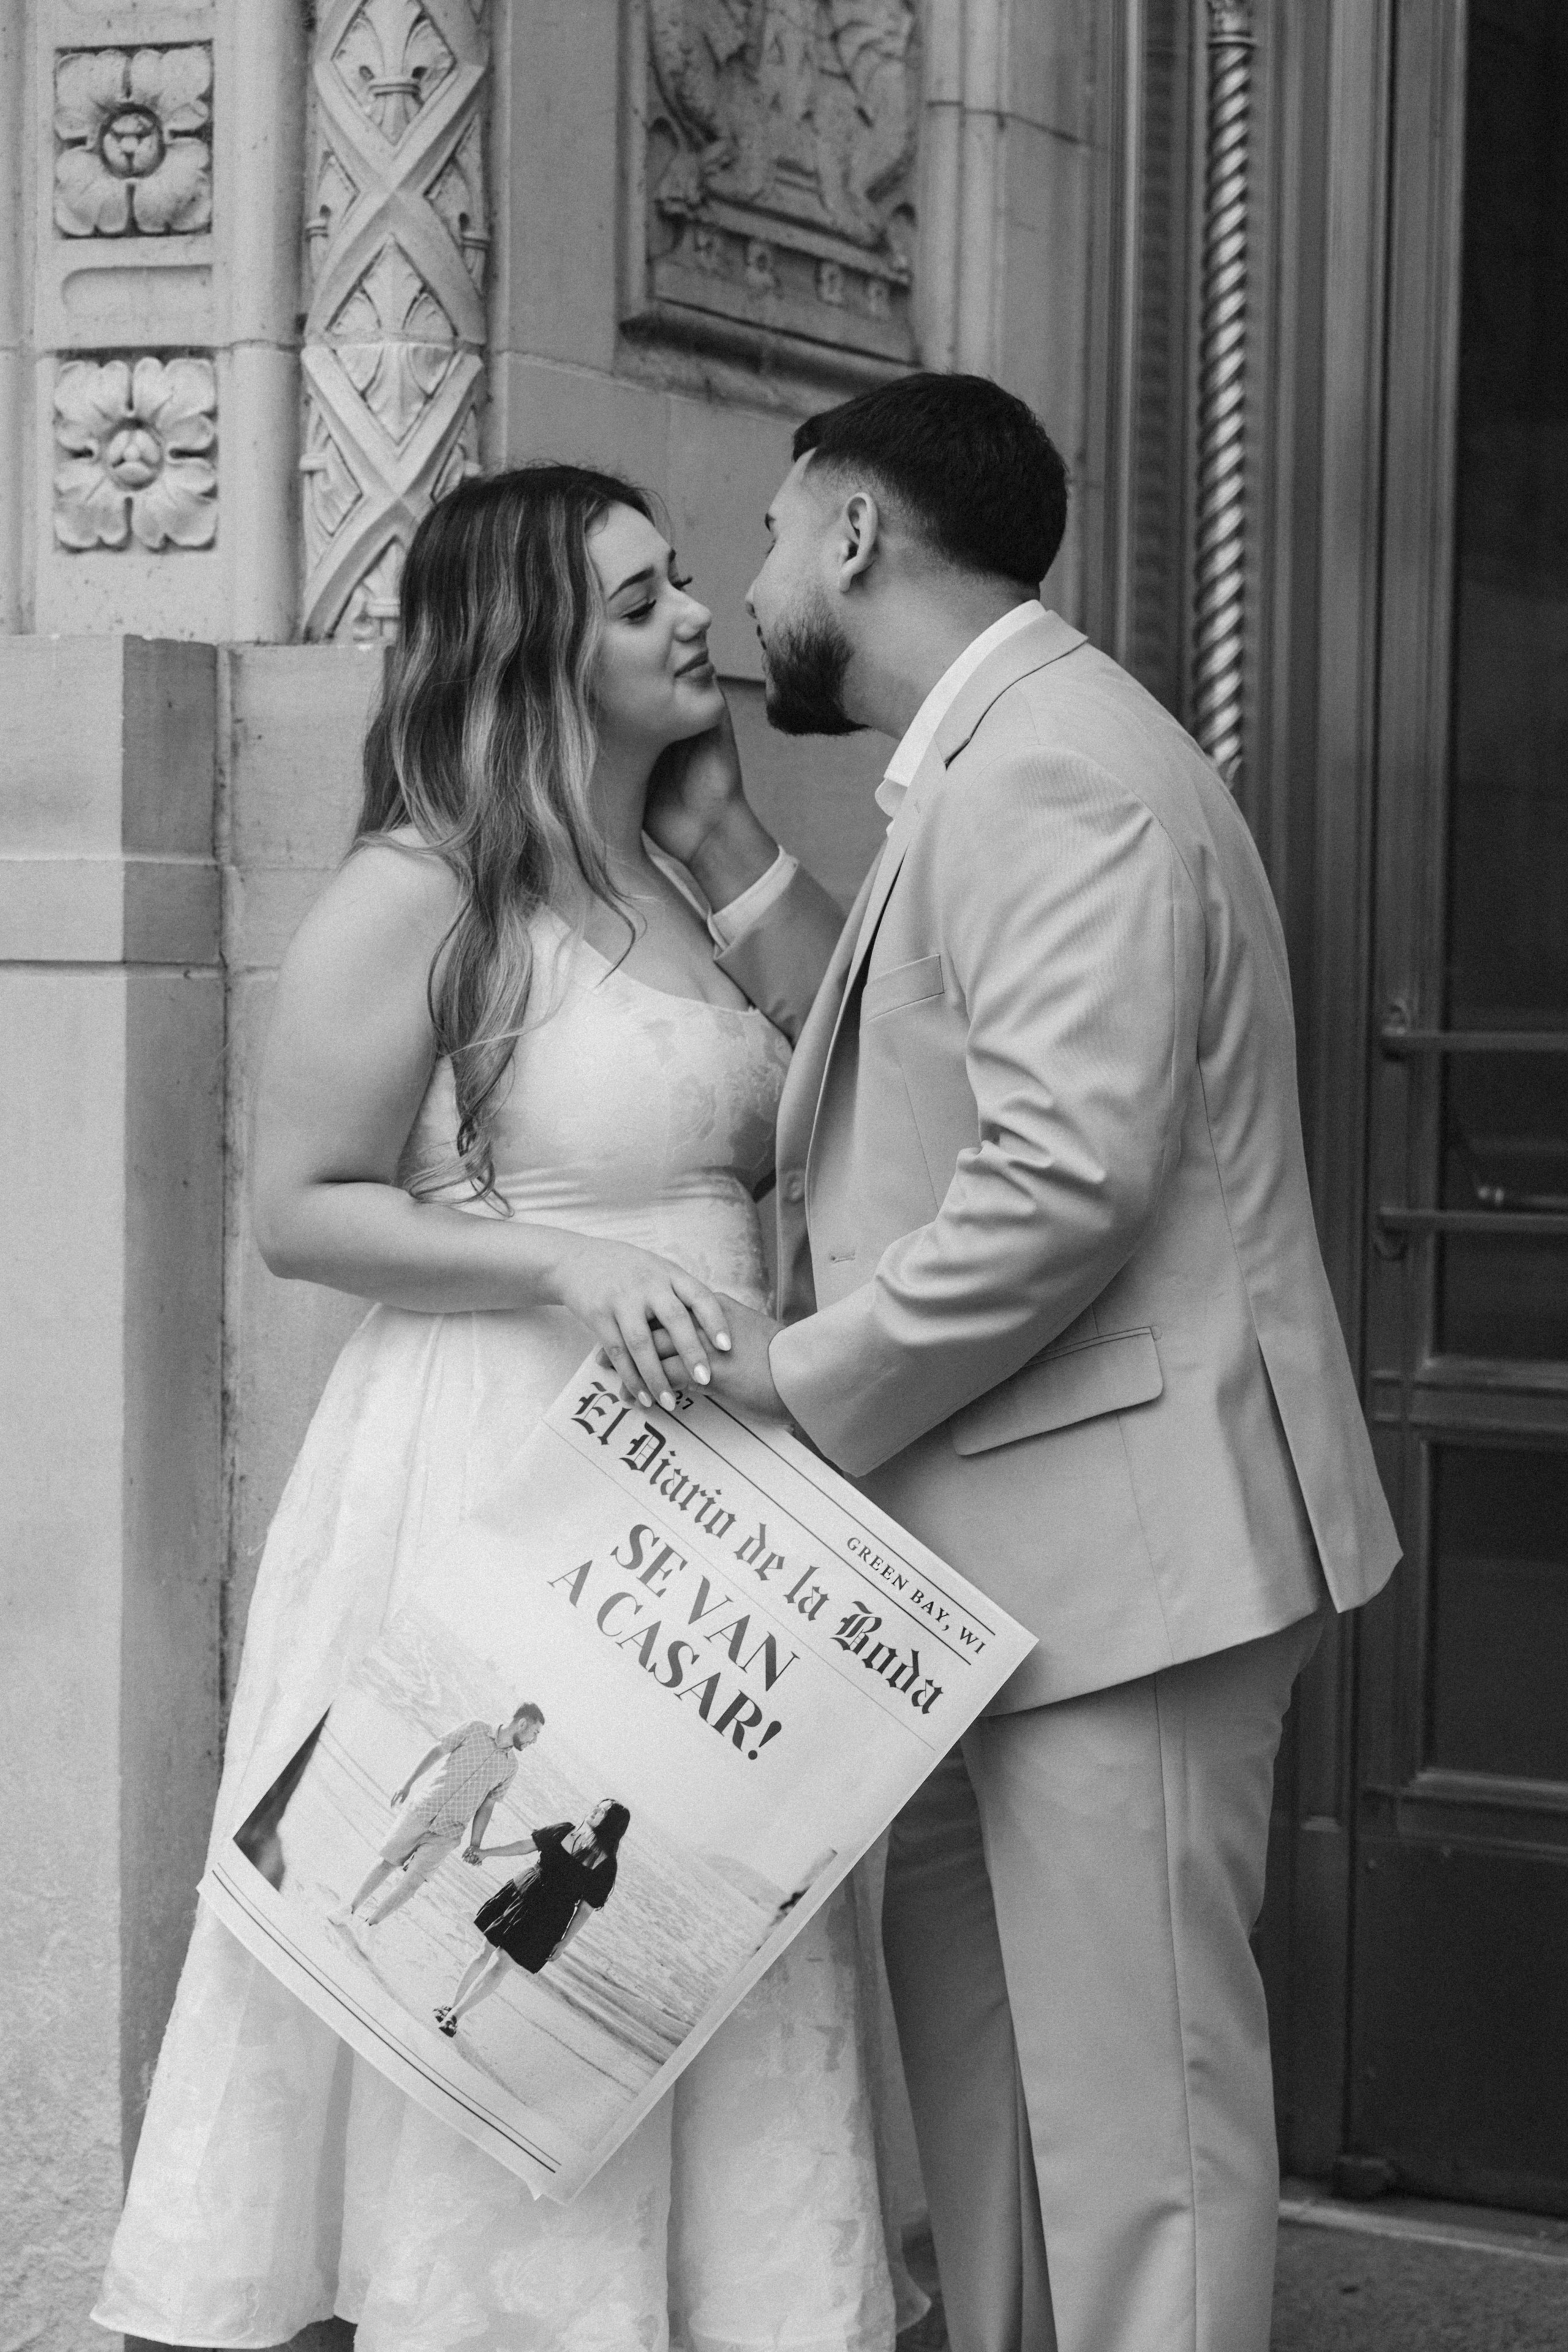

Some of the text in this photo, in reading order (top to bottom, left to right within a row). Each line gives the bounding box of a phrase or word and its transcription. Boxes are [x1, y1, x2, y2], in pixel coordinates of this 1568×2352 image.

[571, 1382, 944, 1714] El Diario de la Boda
[610, 1524, 801, 1692] SE VAN
[847, 1537, 987, 1654] GREEN BAY, WI
[547, 1560, 782, 1760] A CASAR!
